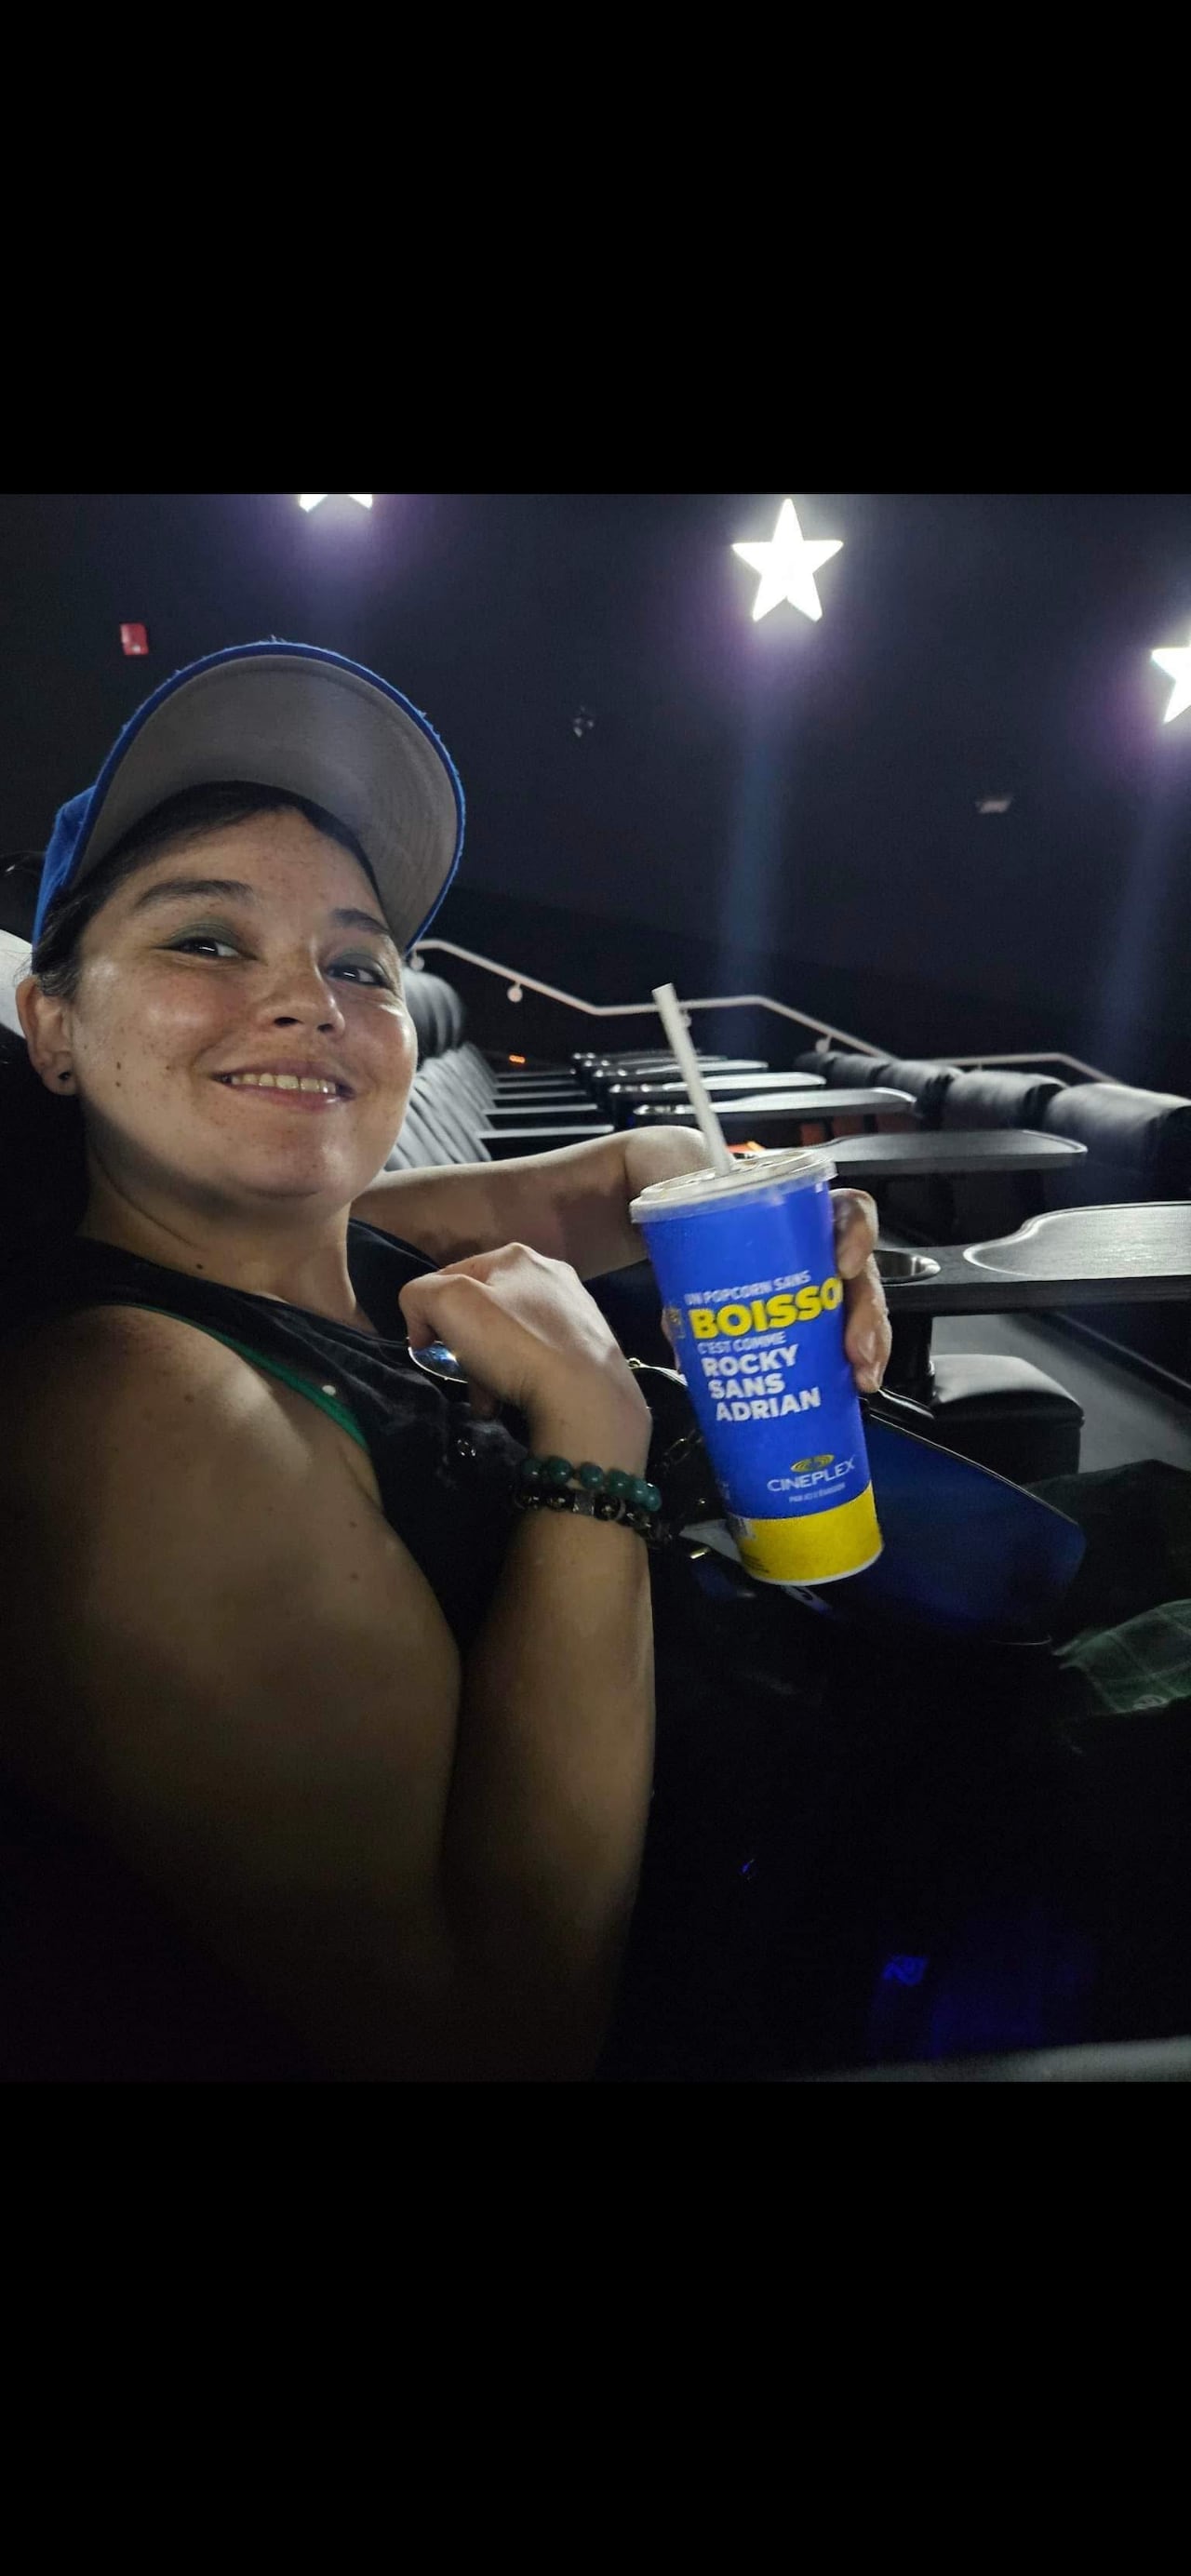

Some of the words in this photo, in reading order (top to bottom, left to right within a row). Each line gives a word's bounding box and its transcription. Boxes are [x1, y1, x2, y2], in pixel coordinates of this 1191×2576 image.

[773, 1270, 811, 1290] SANS
[732, 1330, 786, 1352] COMME
[701, 1343, 798, 1378] ROCKY
[708, 1372, 785, 1399] SANS
[716, 1386, 821, 1421] ADRIAN
[766, 1455, 855, 1492] CINEPLEX
